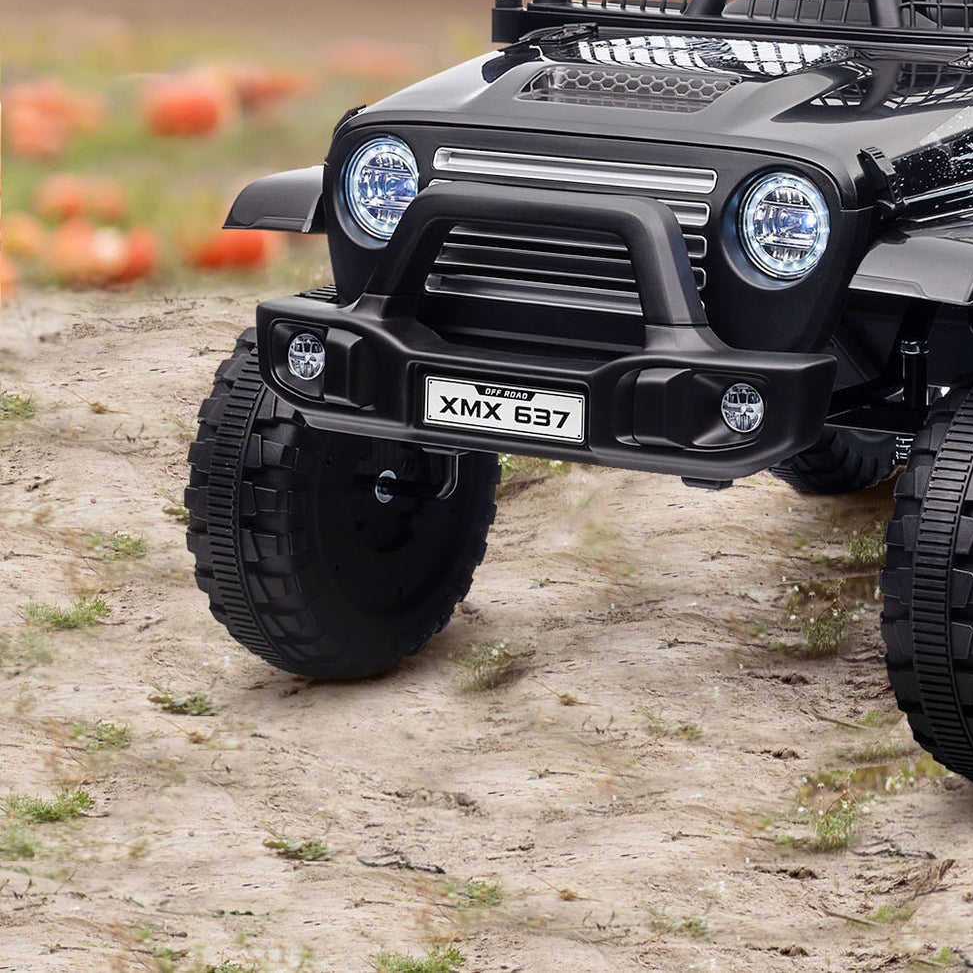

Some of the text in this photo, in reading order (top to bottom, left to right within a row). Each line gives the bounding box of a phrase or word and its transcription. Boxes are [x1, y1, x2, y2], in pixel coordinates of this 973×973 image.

[485, 388, 528, 400] OFF ROAD
[439, 395, 571, 429] XMX 637
